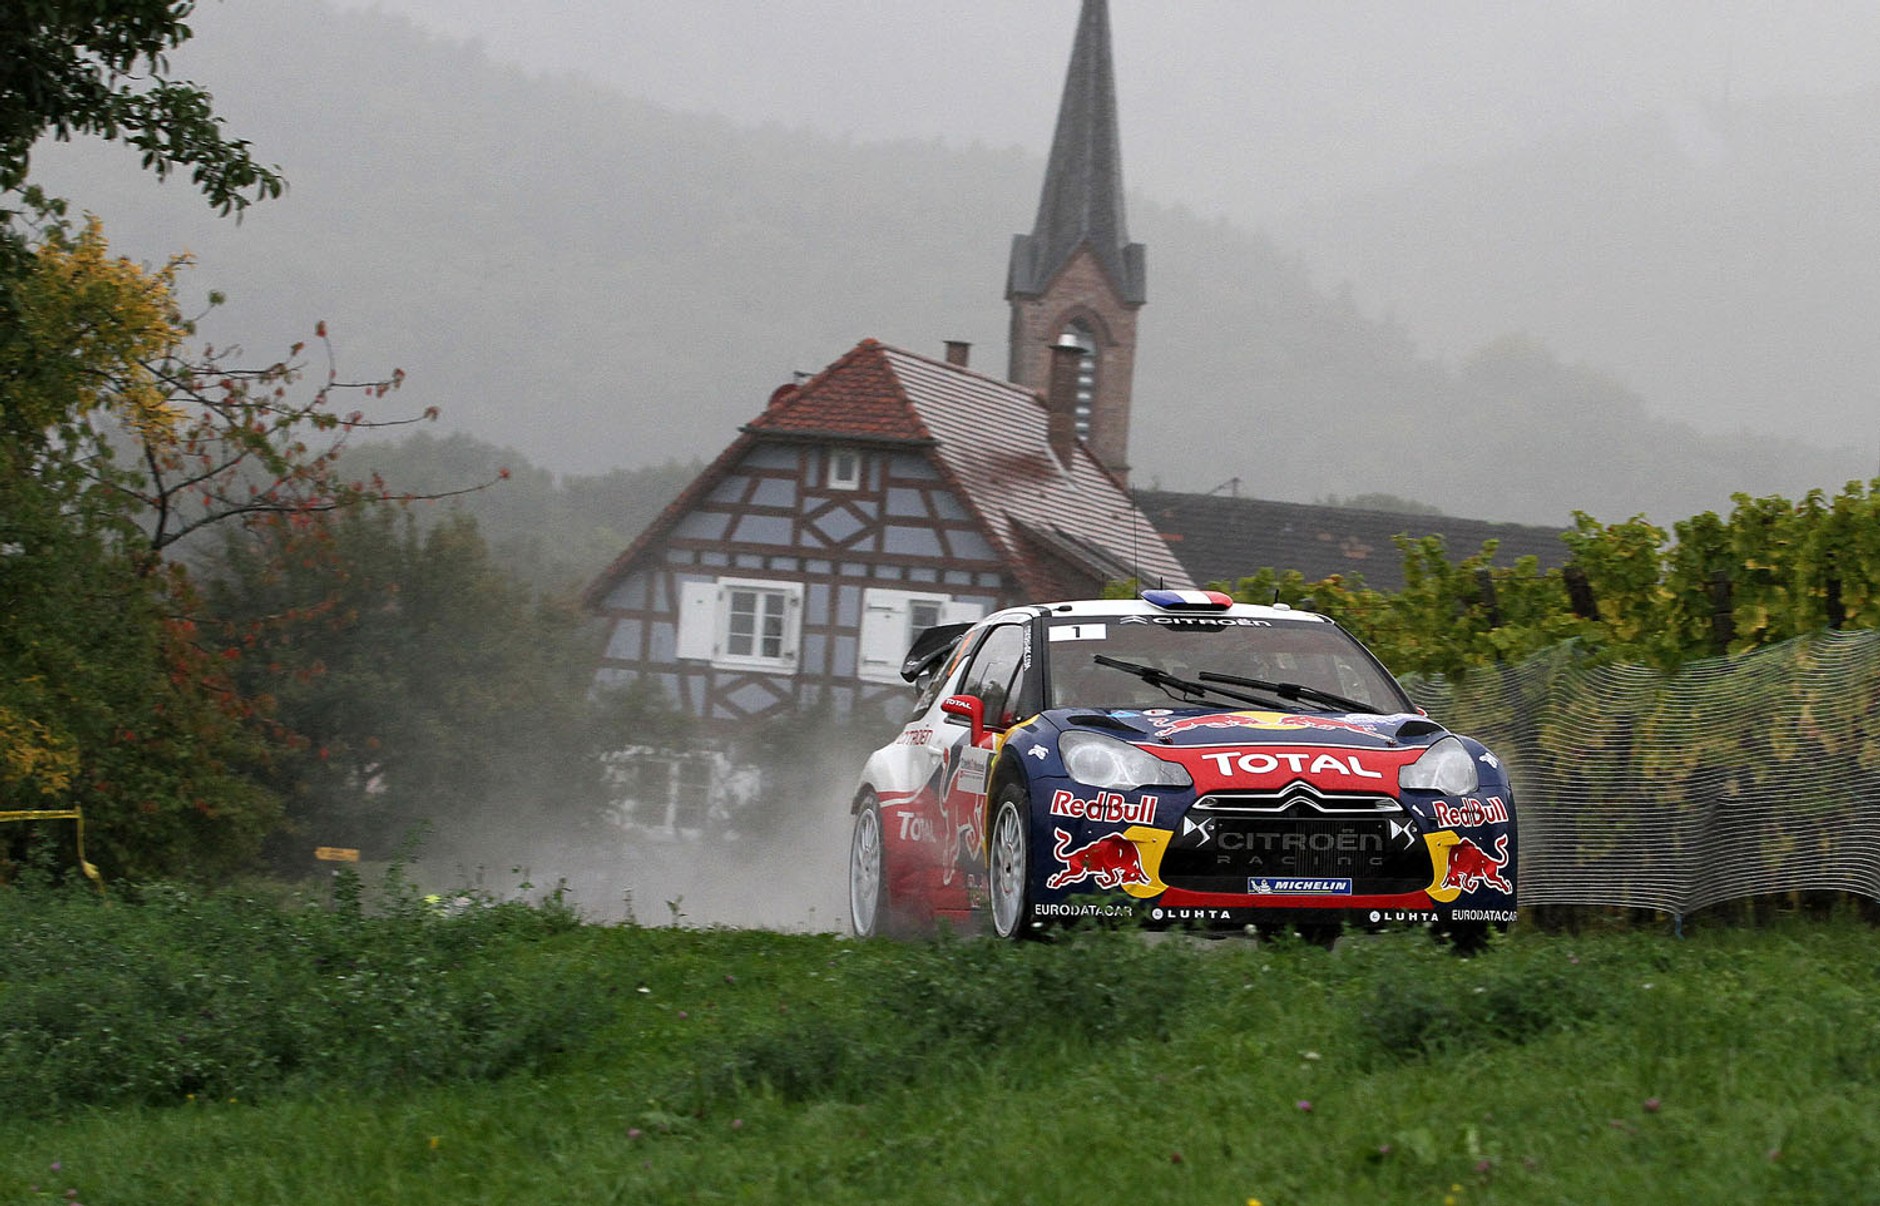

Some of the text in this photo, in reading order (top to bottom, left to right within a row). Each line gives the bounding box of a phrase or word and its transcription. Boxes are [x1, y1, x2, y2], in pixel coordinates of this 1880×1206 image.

[1071, 625, 1081, 638] 1
[945, 698, 972, 711] TOTAL
[1201, 751, 1383, 779] TOTAL
[1216, 855, 1384, 866] RACING
[1274, 881, 1347, 891] MICHELIN
[1167, 910, 1231, 919] LUHTA
[1384, 912, 1439, 922] LUHTA
